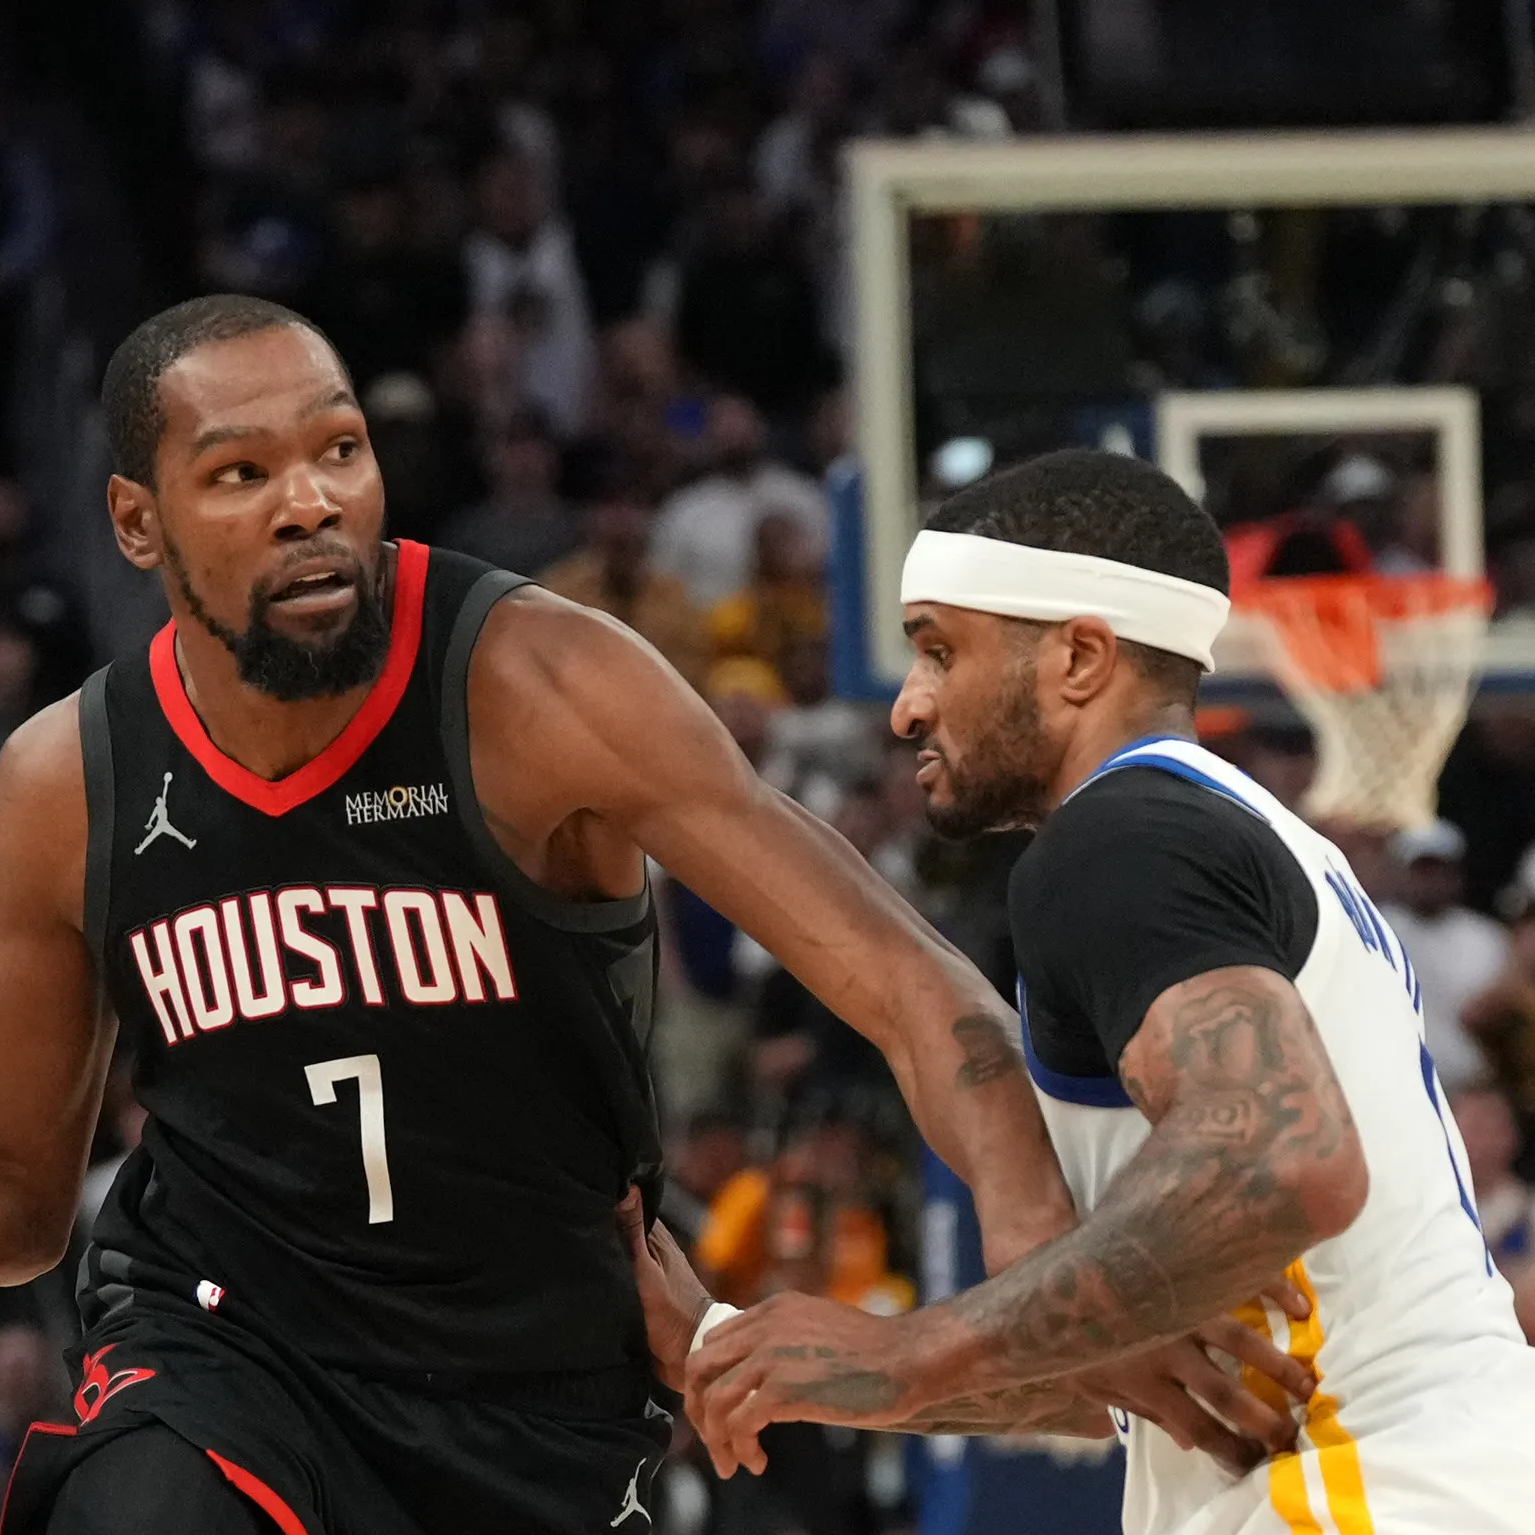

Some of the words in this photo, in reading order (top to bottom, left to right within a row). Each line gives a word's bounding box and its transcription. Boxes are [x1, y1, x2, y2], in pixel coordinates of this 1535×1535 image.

[346, 783, 448, 811] MEMORIAL
[346, 797, 448, 825] HERMANN
[128, 883, 519, 1048] HOUSTON
[303, 1053, 394, 1225] 7
